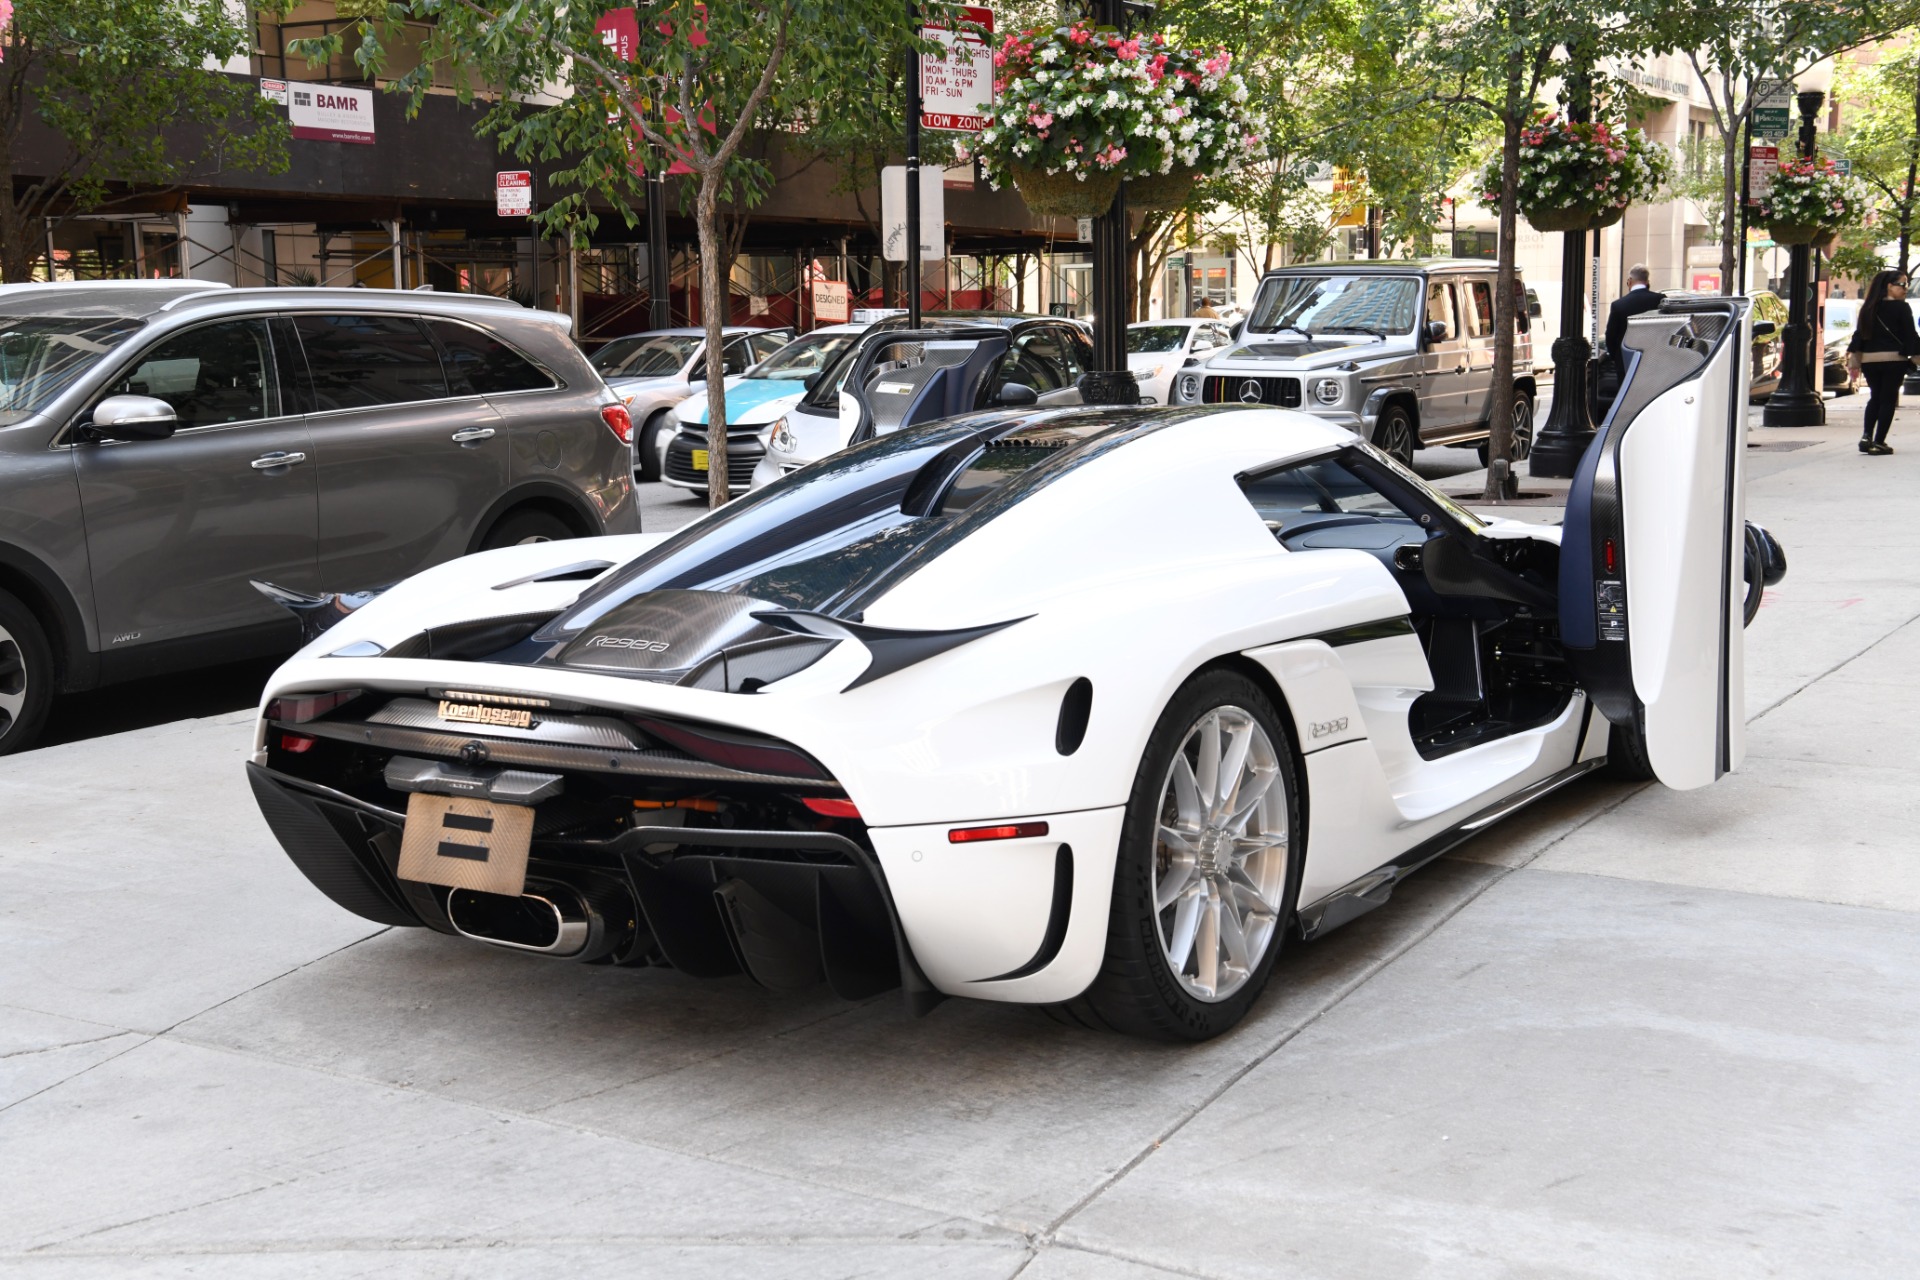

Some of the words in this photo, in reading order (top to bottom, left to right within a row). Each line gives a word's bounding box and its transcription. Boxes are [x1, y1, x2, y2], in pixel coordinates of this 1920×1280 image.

[925, 54, 934, 64] 10
[925, 65, 943, 75] MON
[951, 67, 978, 79] THURS
[925, 75, 934, 85] 10
[935, 76, 947, 86] AM
[954, 78, 960, 88] 6
[961, 78, 973, 89] PM
[925, 85, 939, 96] FRI
[946, 87, 963, 98] SUN
[316, 94, 358, 111] BAMR
[926, 114, 952, 127] TOW
[957, 116, 988, 130] ZONE
[815, 293, 846, 305] DESIGNED
[112, 632, 141, 644] AWD
[586, 635, 670, 653] Regera
[437, 700, 532, 728] Koenigsegg
